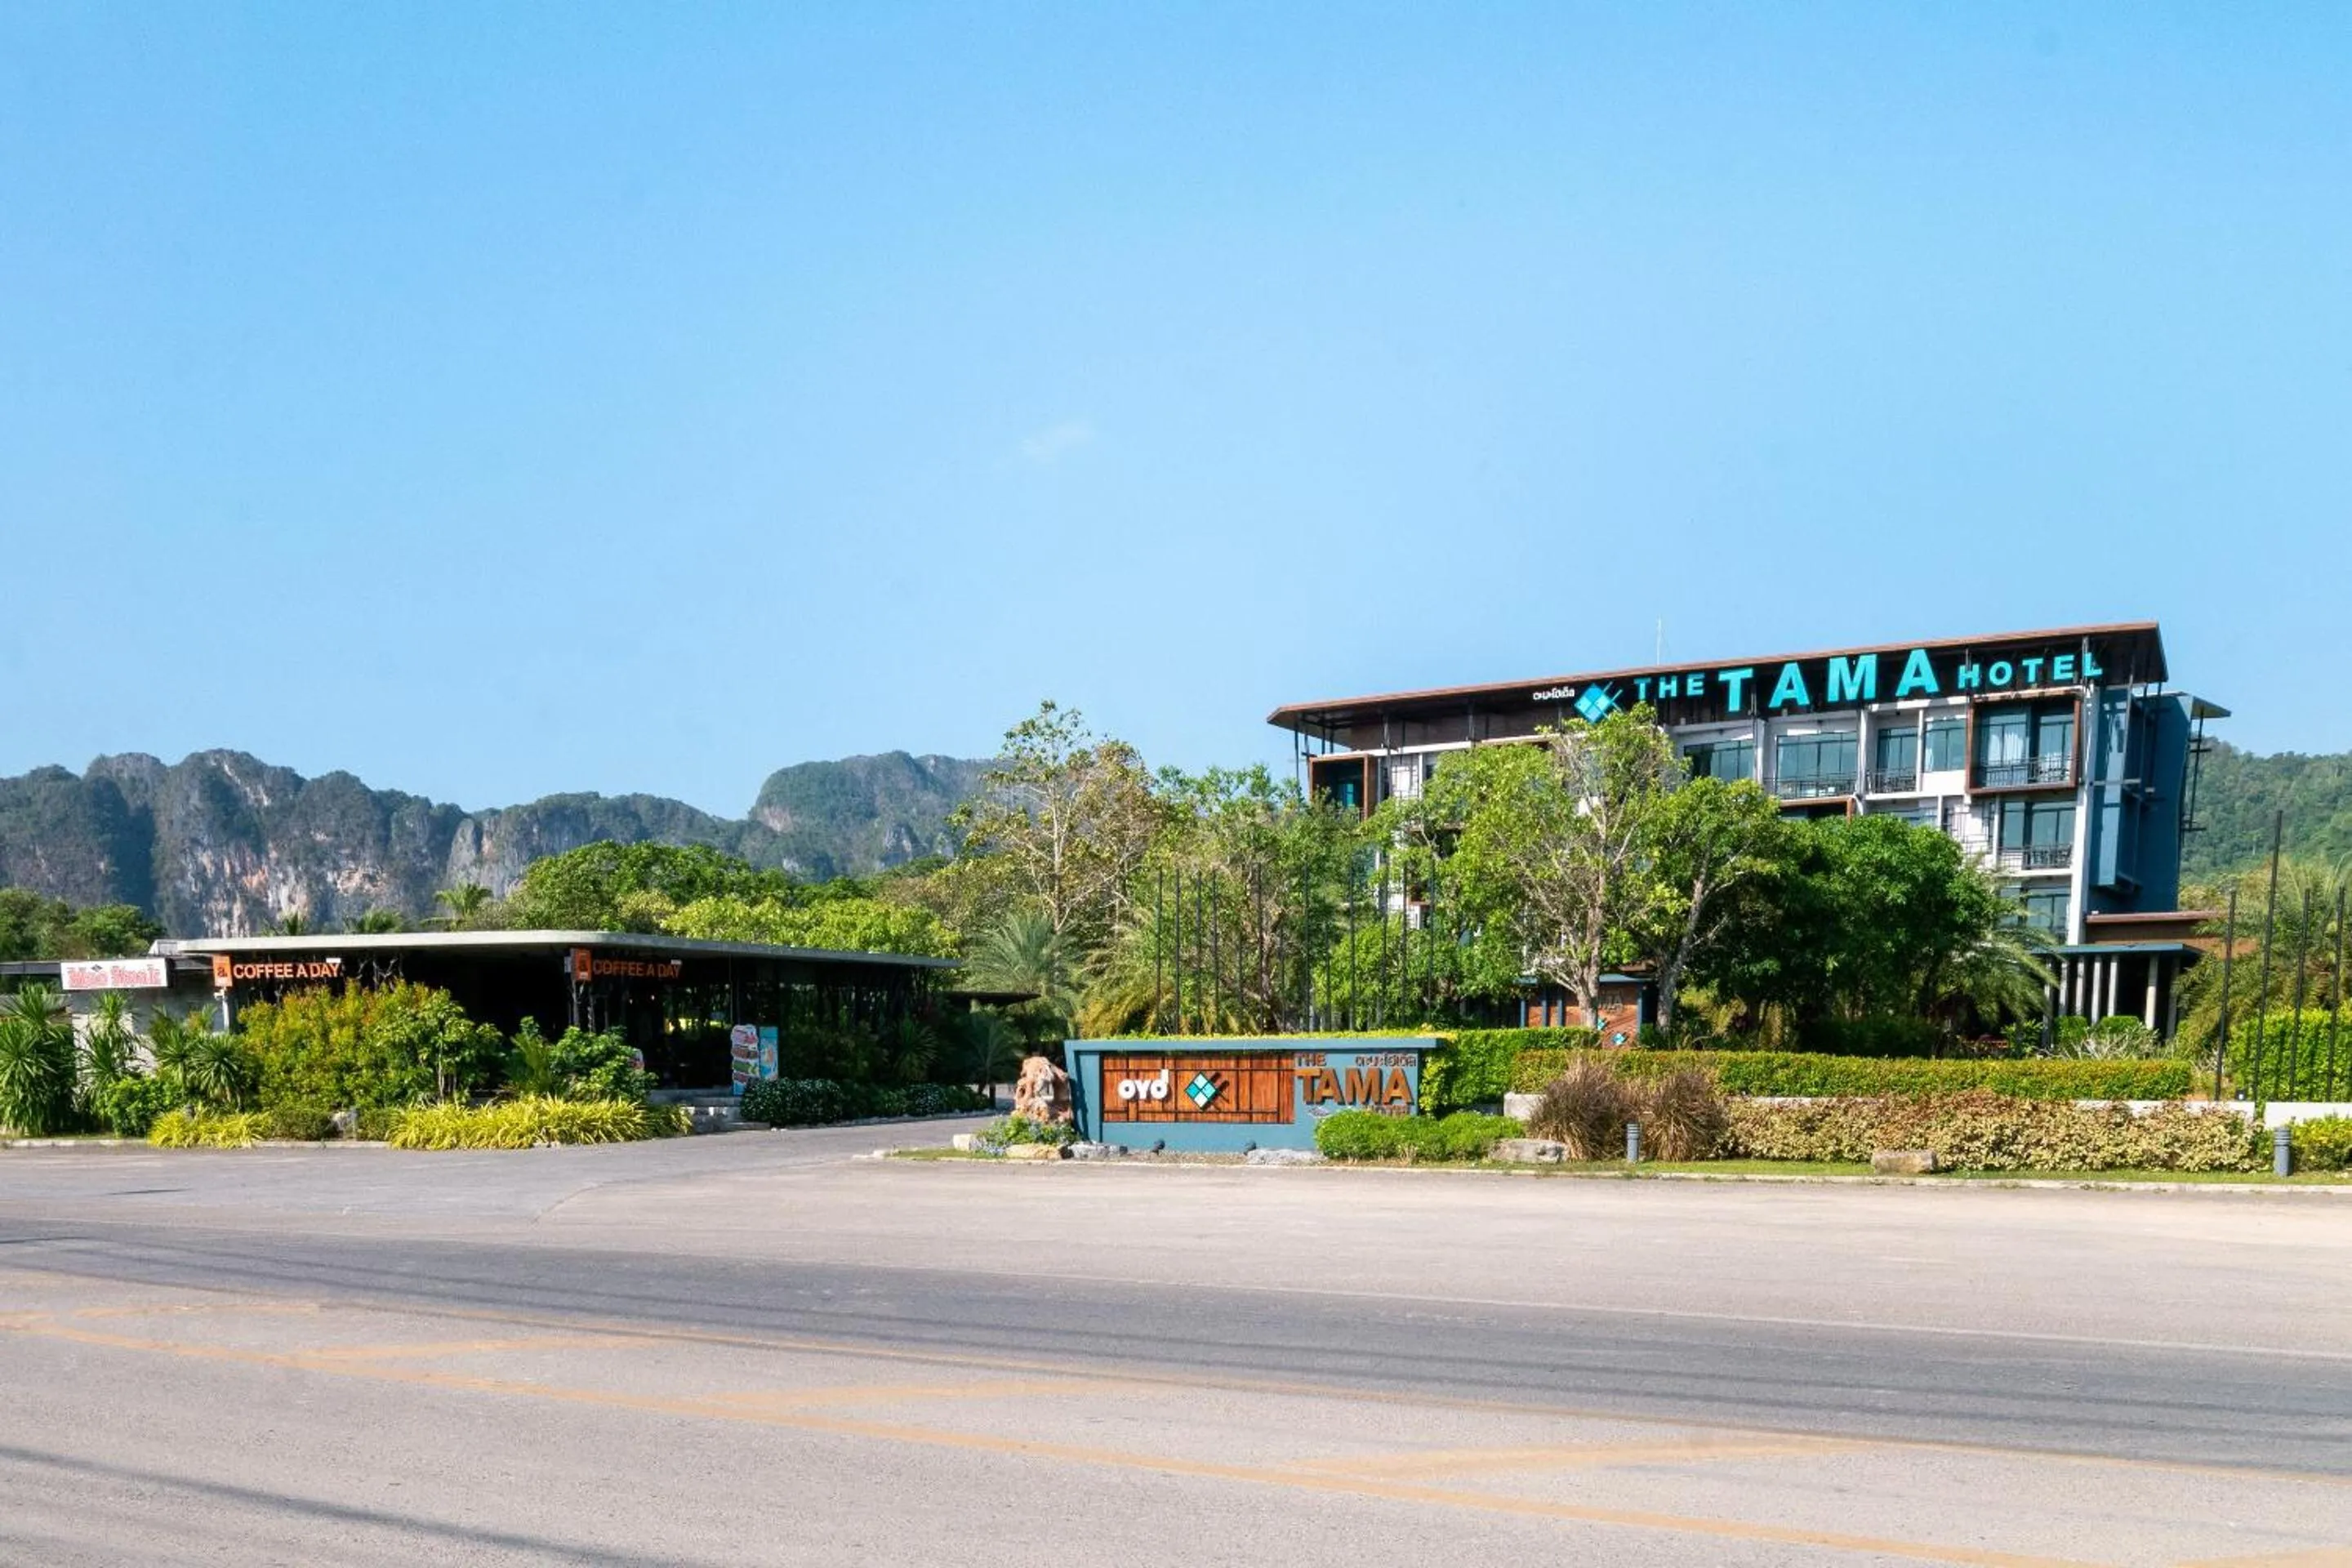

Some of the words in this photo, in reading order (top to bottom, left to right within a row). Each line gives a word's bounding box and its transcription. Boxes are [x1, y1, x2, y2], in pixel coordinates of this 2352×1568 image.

[1633, 672, 1705, 702] THE
[1717, 648, 1940, 713] TAMA
[1958, 652, 2104, 689] HOTEL
[233, 964, 294, 979] COFFEE
[296, 964, 308, 978] A
[310, 963, 340, 978] DAY
[593, 960, 644, 977] COFFEE
[646, 964, 655, 978] A
[657, 964, 682, 978] DAY
[1293, 1052, 1327, 1067] THE
[1294, 1067, 1414, 1106] TAMA
